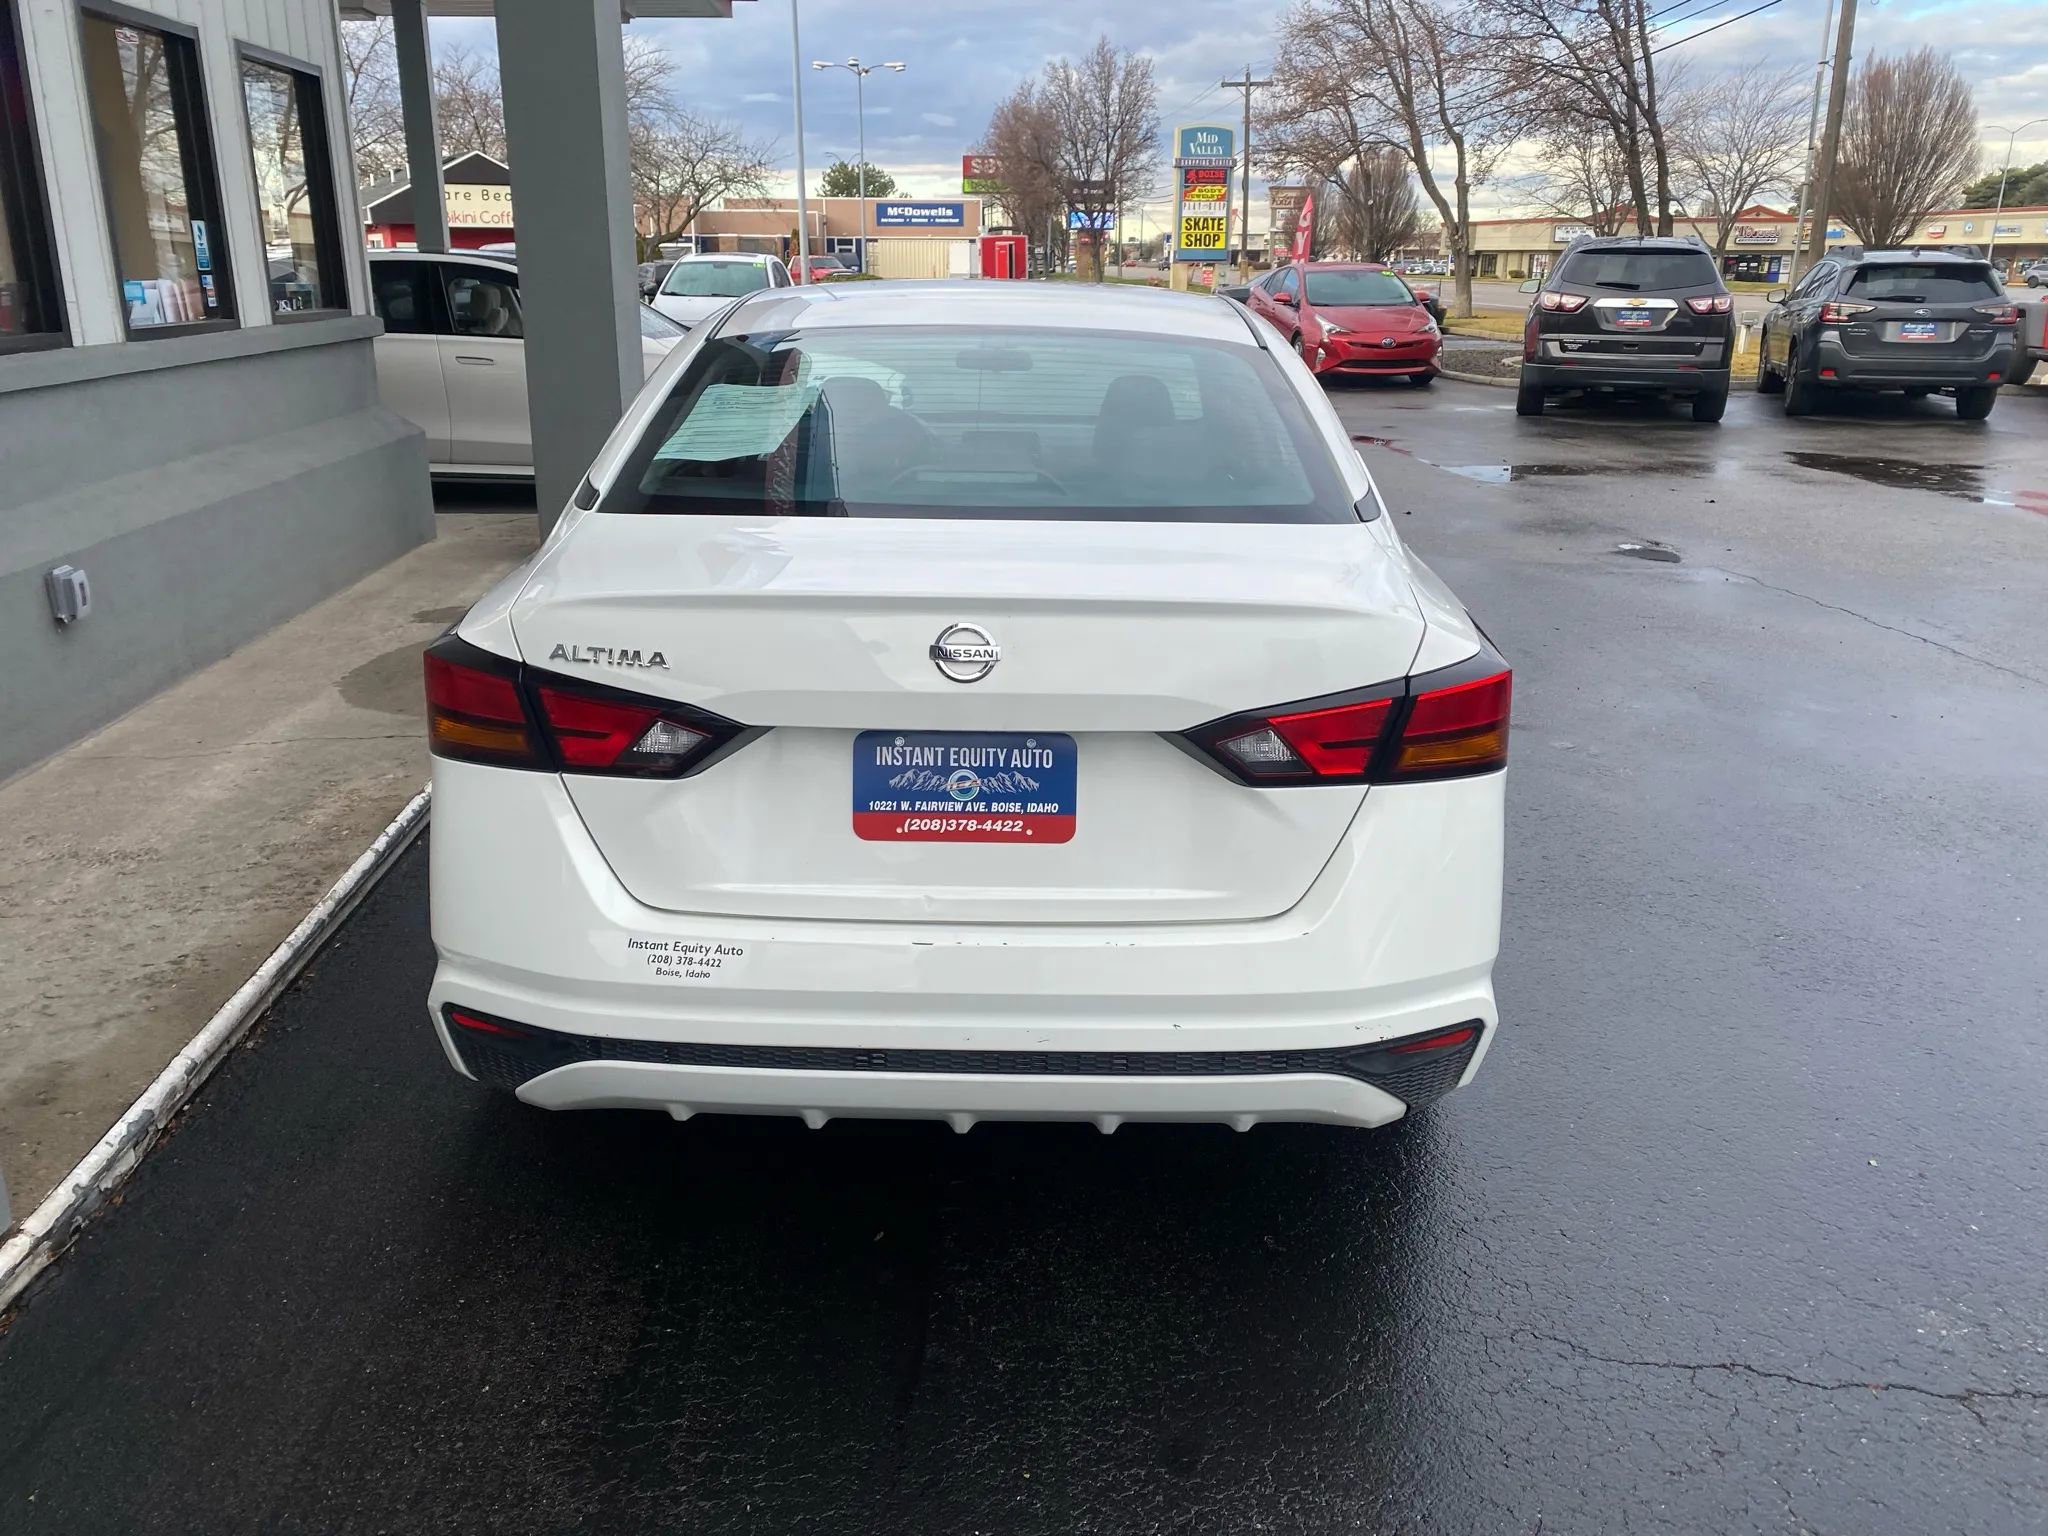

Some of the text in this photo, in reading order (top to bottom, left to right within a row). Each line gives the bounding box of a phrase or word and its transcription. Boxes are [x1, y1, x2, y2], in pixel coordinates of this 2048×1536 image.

[1190, 142, 1224, 155] VALLEY
[1185, 217, 1224, 231] SKATE
[1185, 233, 1221, 247] SHOP
[549, 643, 670, 669] ALTIMA
[937, 648, 994, 659] NISSAN
[876, 746, 1053, 769] INSTANT EQUITY AUTO
[868, 800, 1059, 814] 10221 W. FAIRVIEW AVE. BOISE, IDAHO
[904, 818, 1024, 833] (208)378-4422
[627, 938, 744, 957] Instant Equity Auto
[647, 954, 722, 968] (208) 378-4422
[655, 967, 711, 979] Boise, Idaho
